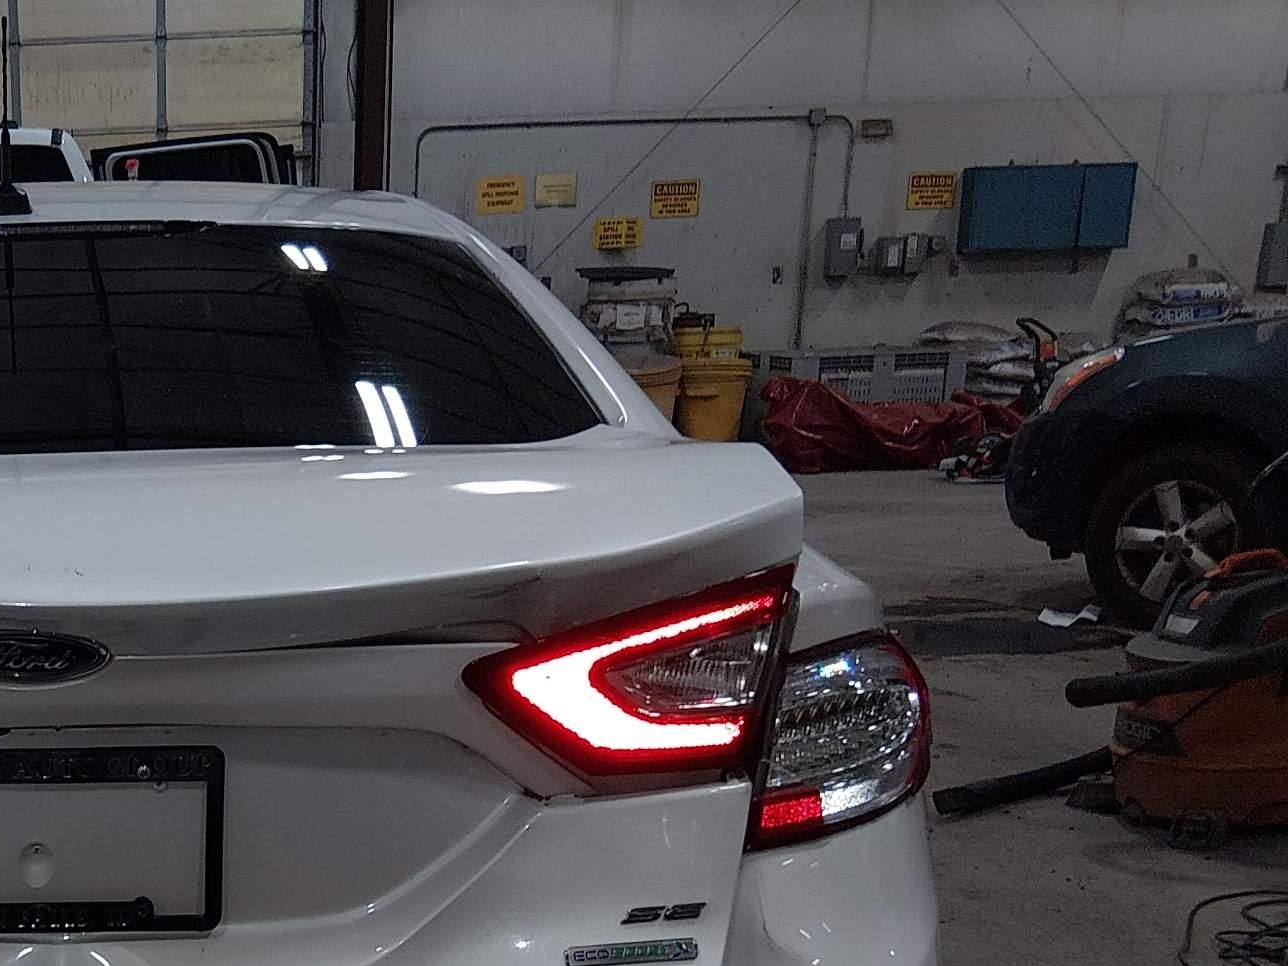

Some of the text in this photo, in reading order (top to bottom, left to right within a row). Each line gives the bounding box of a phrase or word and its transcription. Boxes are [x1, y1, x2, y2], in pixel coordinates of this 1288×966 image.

[913, 176, 953, 186] CAUTION
[655, 184, 696, 195] CAUTION
[620, 902, 708, 926] SE
